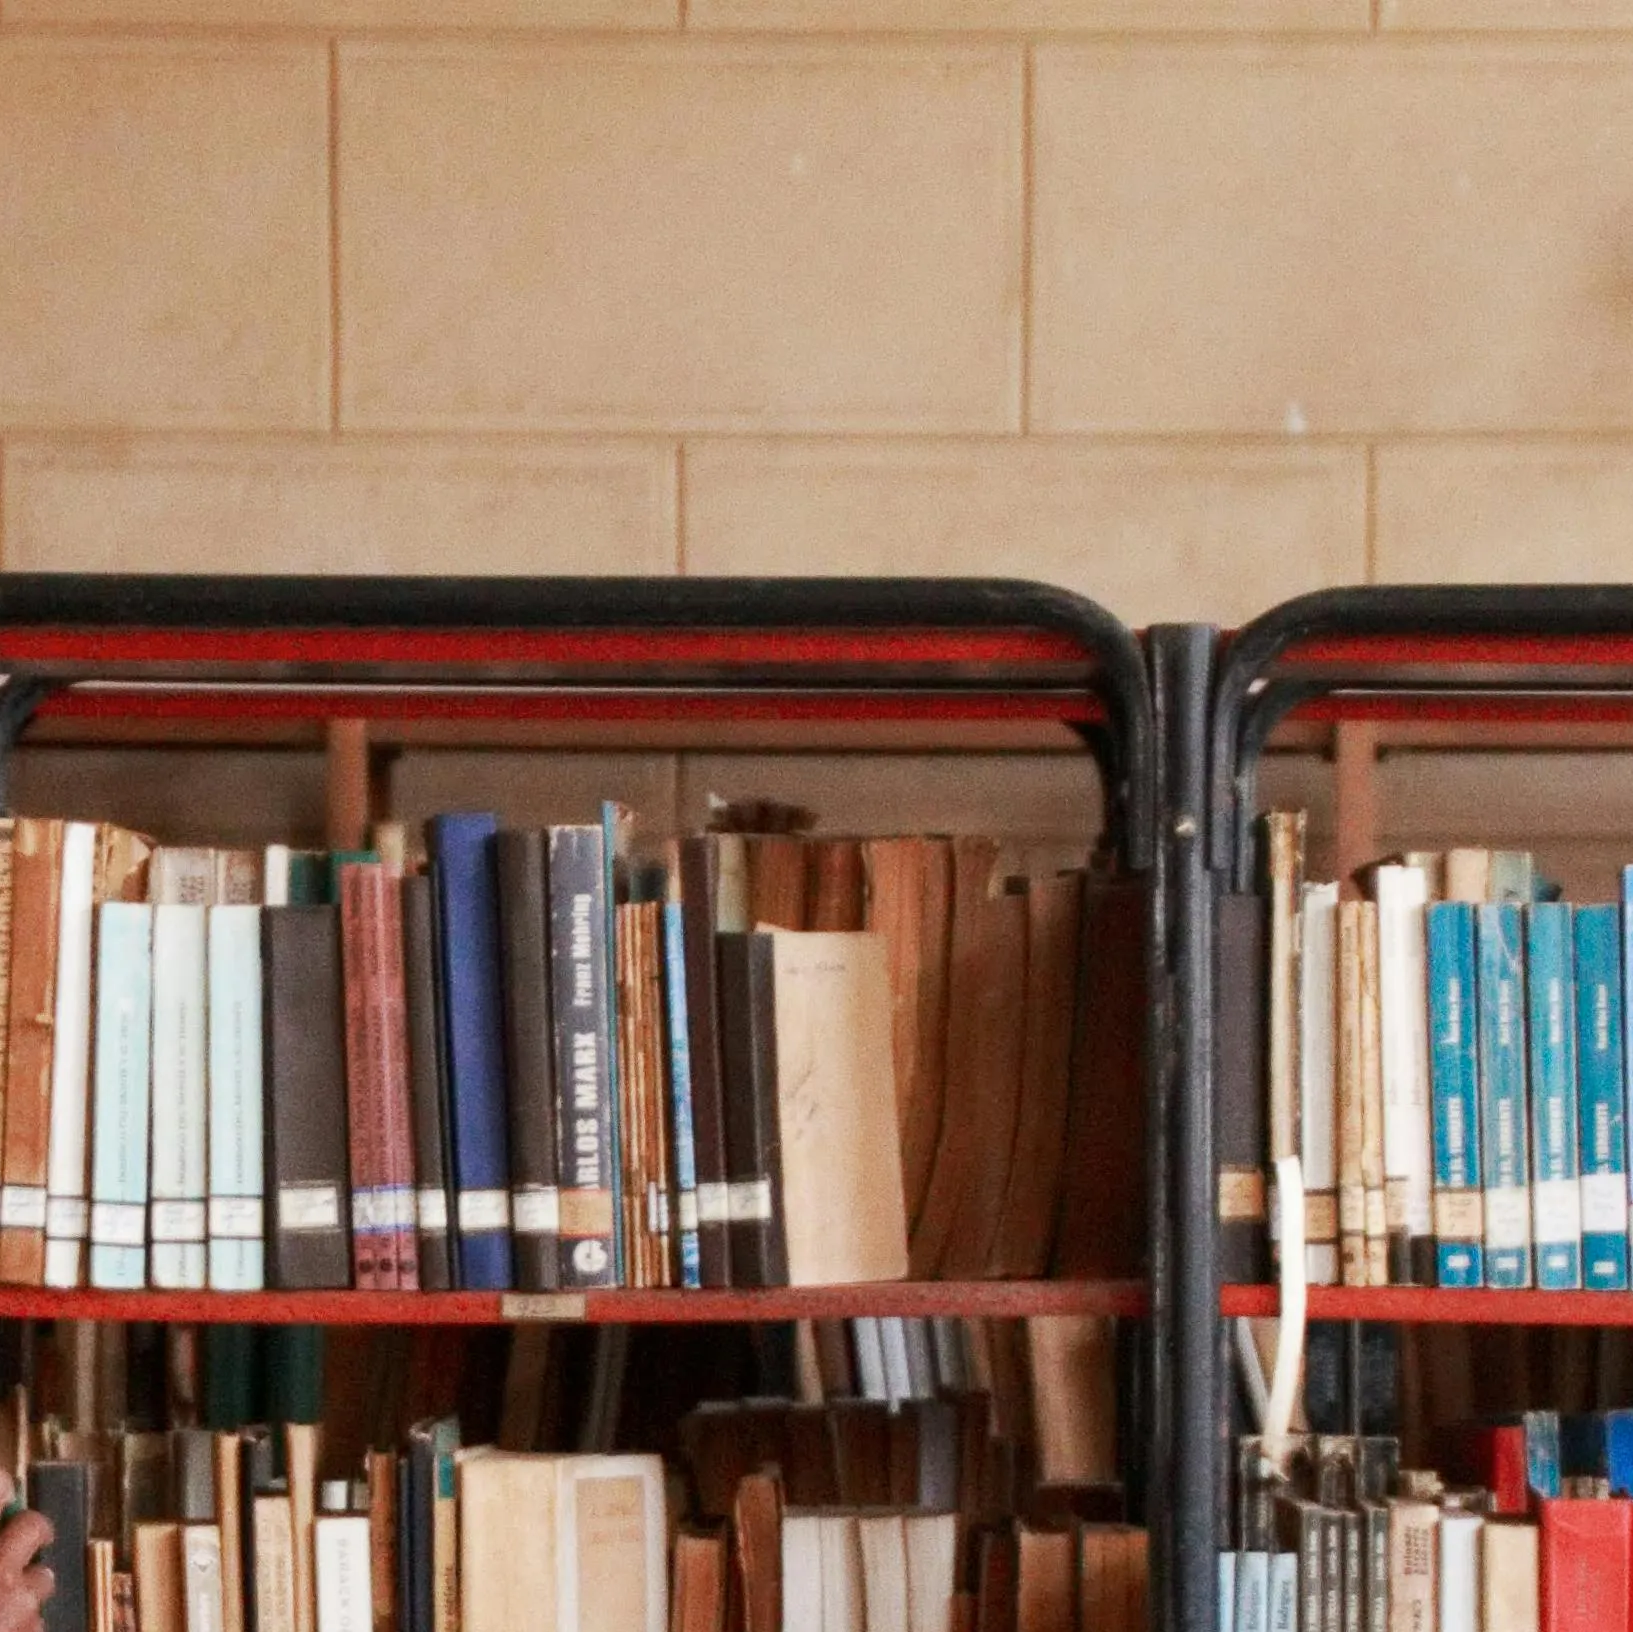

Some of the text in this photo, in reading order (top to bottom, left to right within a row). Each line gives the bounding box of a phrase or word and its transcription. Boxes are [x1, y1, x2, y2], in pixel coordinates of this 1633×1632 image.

[569, 893, 593, 1007] Franz Mehring
[572, 1031, 601, 1190] RLOS MARX
[335, 1538, 351, 1611] BARACK
